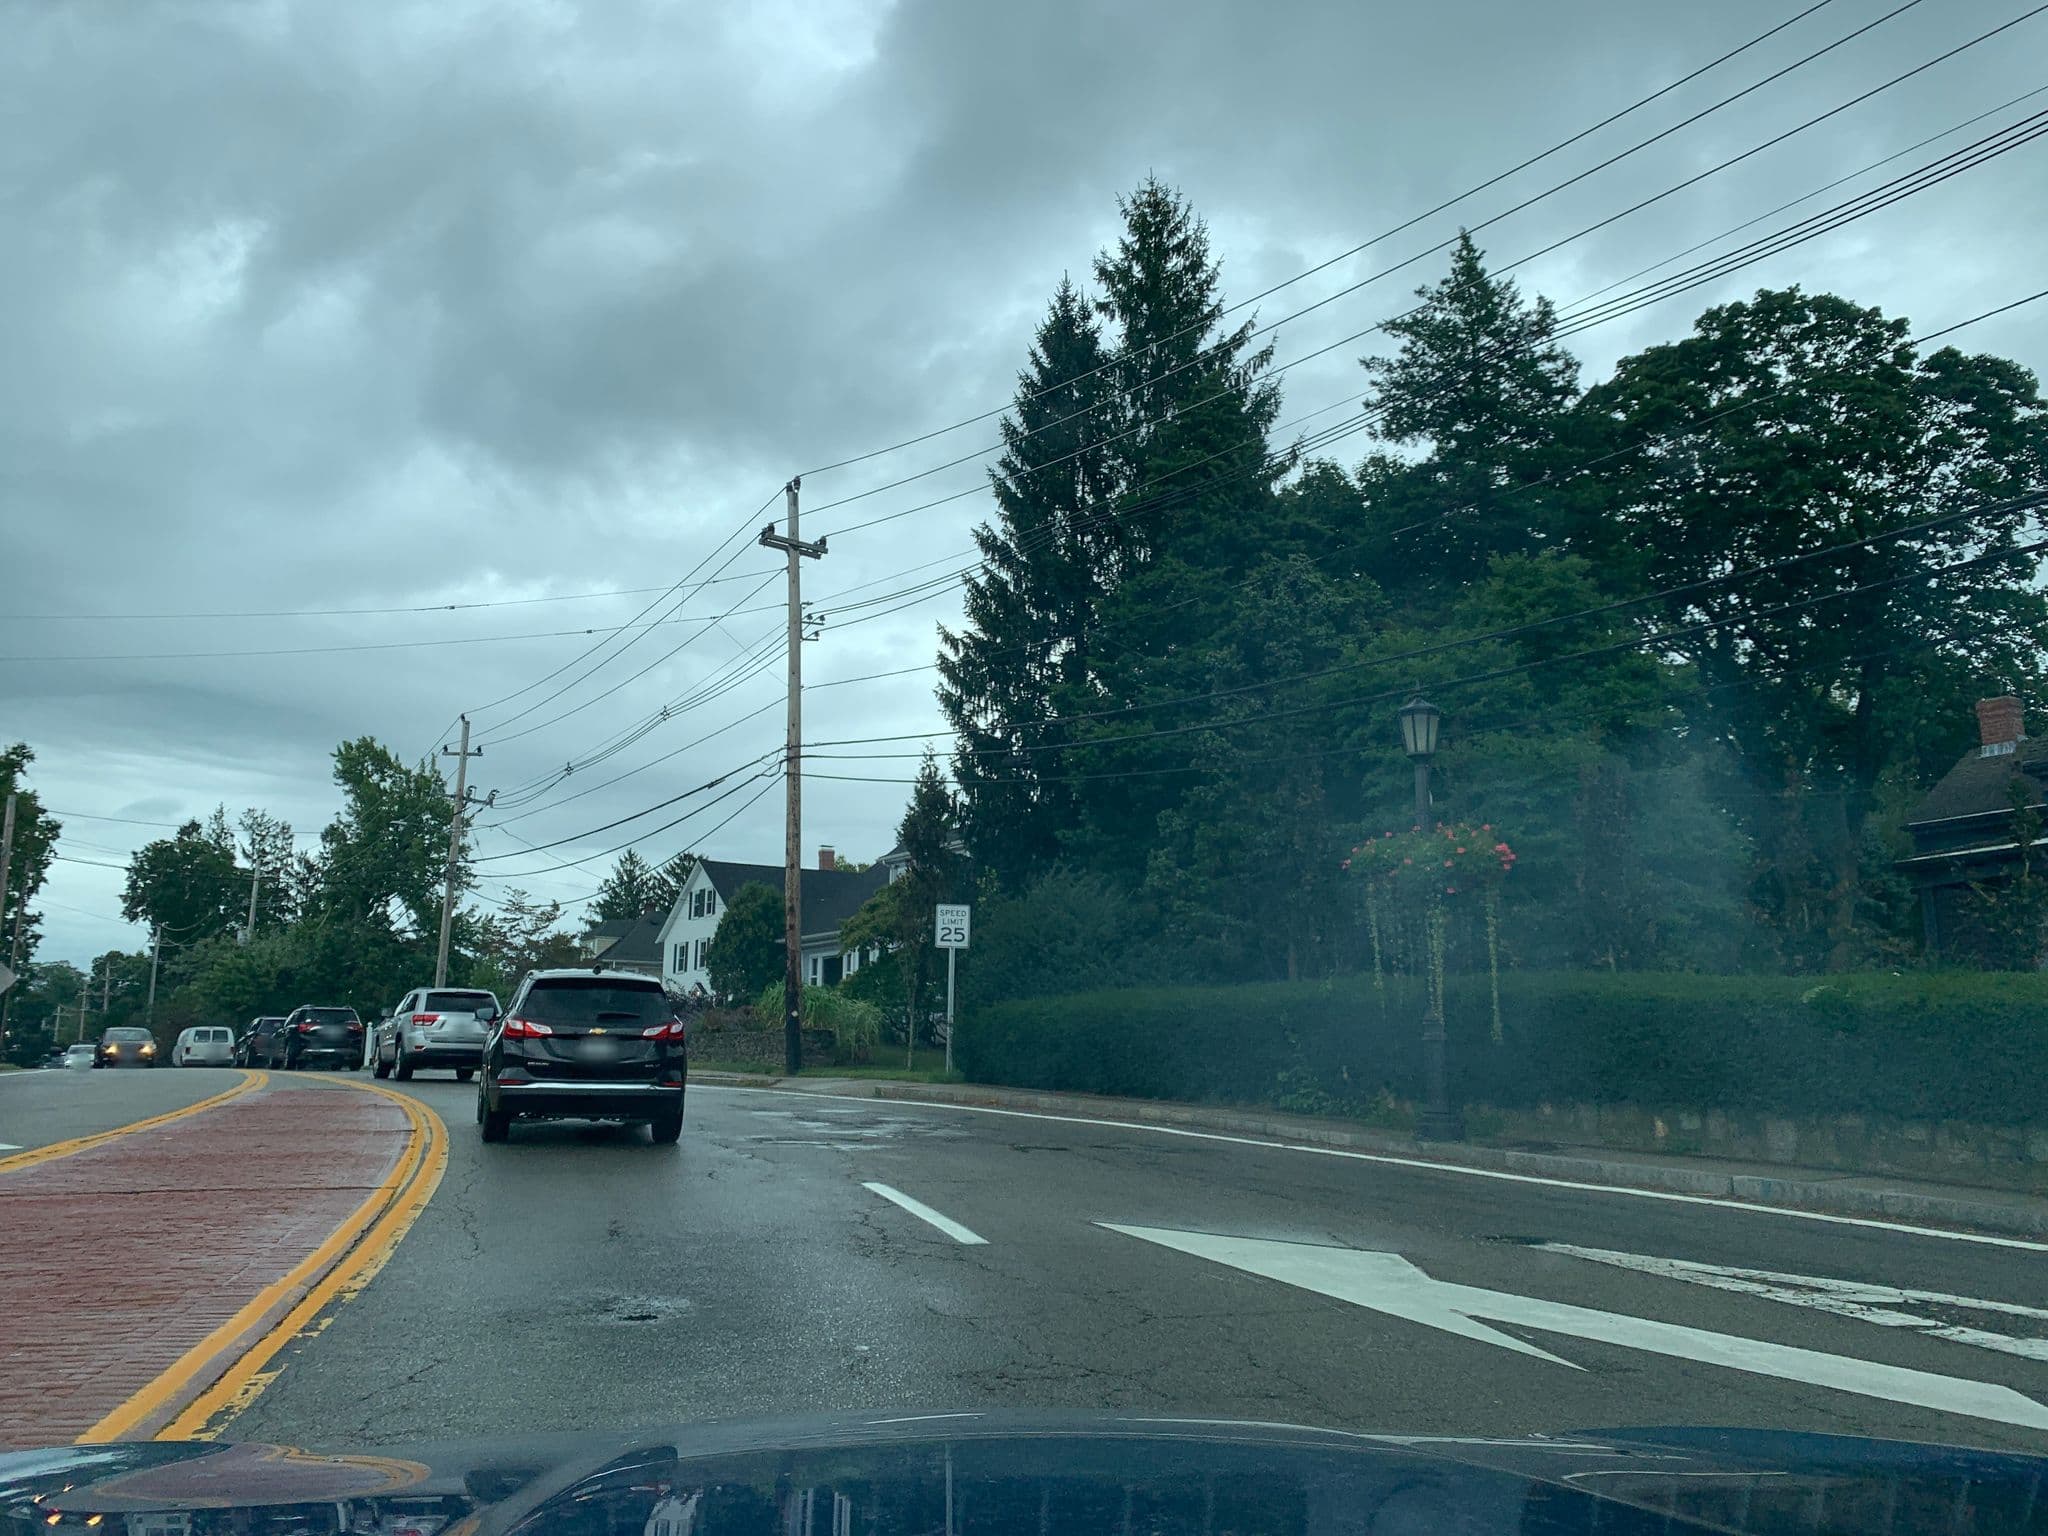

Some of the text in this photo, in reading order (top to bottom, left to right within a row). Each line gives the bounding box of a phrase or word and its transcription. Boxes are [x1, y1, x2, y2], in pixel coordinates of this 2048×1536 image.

[940, 909, 967, 917] SPEED
[943, 918, 964, 926] LIMIT
[940, 927, 965, 943] 25
